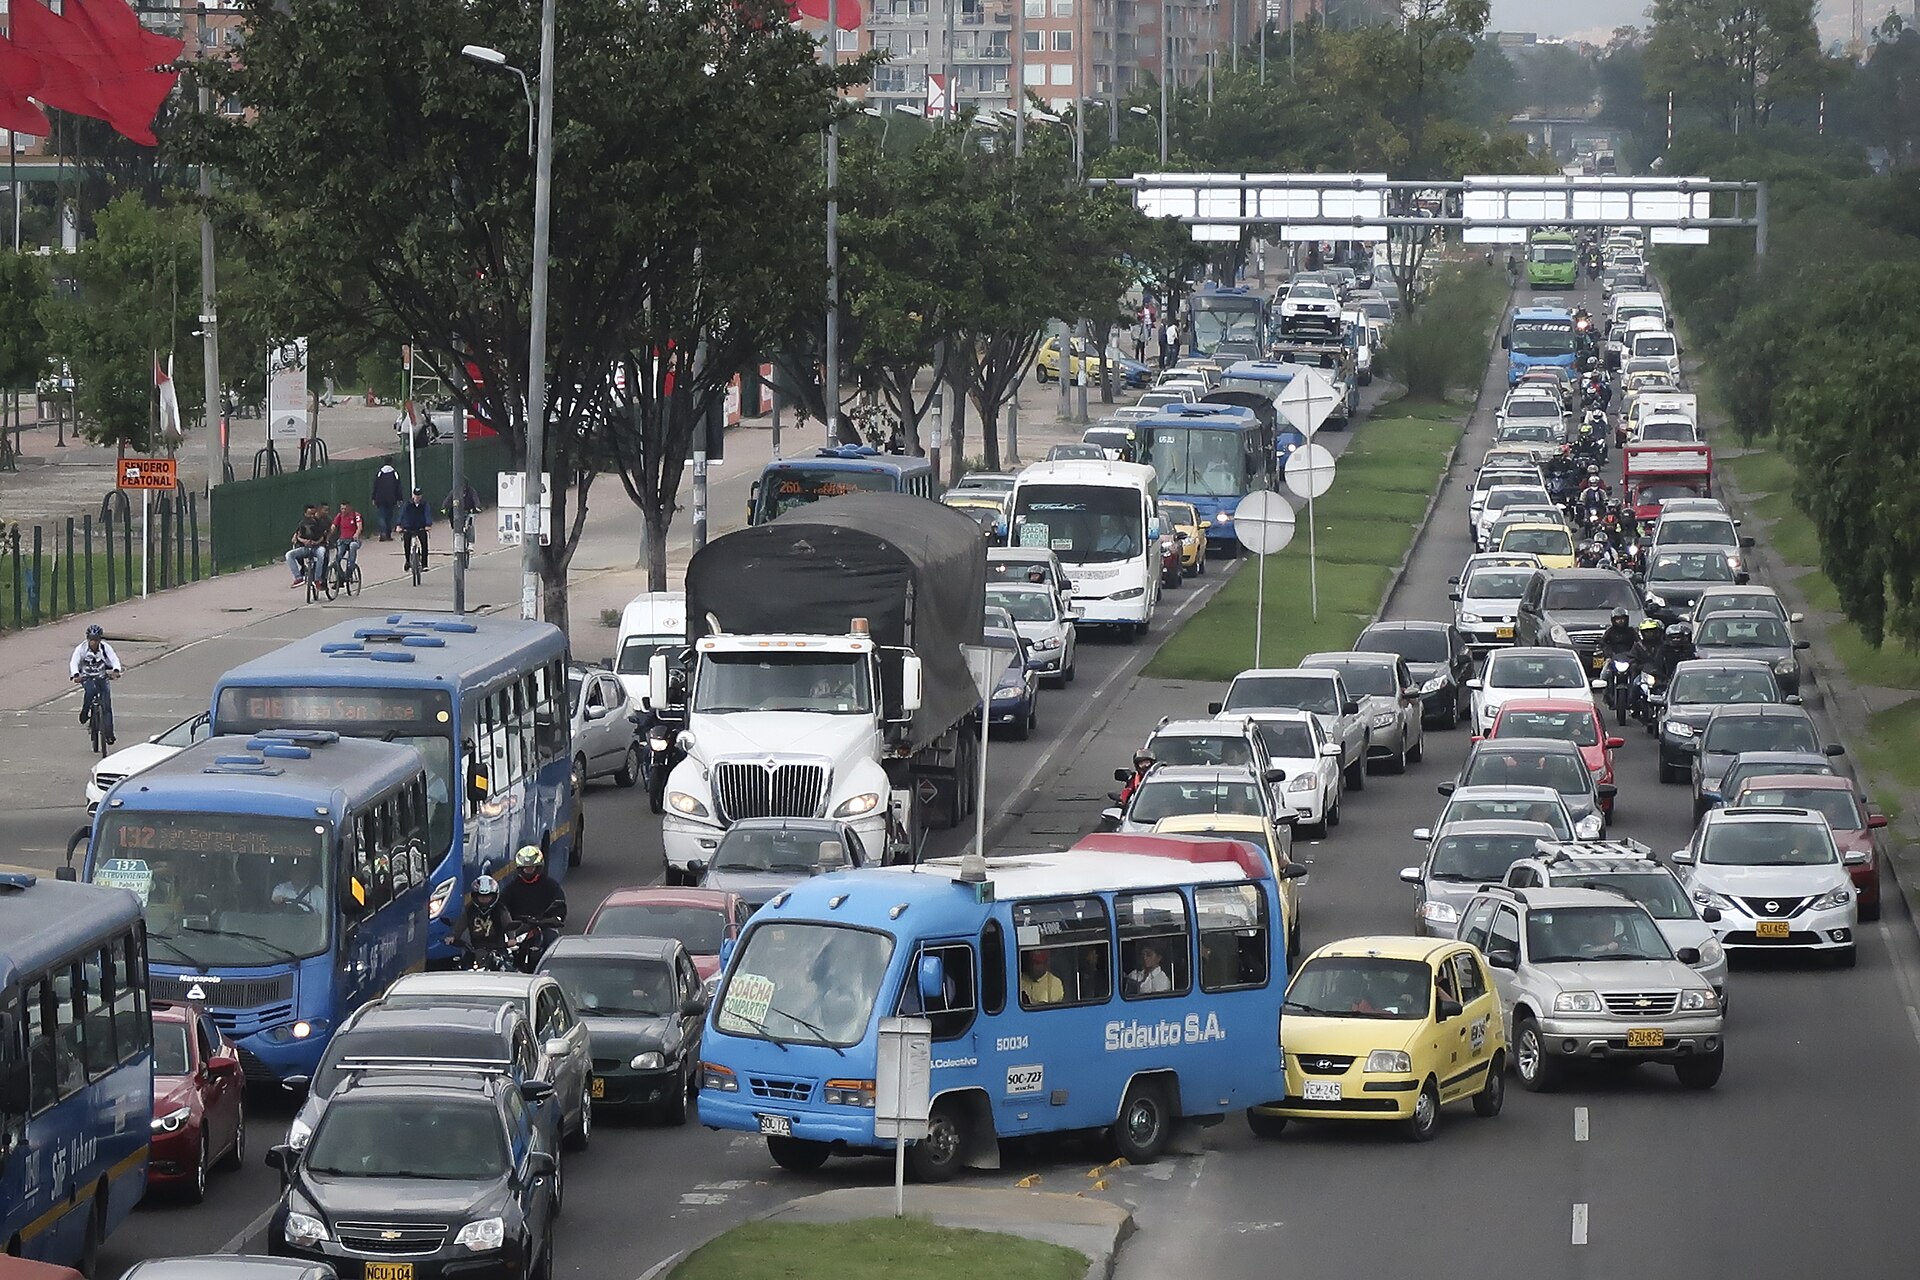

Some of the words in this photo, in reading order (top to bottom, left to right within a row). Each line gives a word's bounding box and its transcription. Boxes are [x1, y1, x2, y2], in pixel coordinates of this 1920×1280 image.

[124, 461, 170, 473] SENDERO
[121, 475, 172, 486] PEATONAL
[118, 825, 155, 849] 132
[116, 860, 137, 871] 132
[179, 974, 221, 984] Marcopolo
[728, 978, 773, 1002] SOACHA
[724, 997, 767, 1017] COMPARTIR
[1105, 1018, 1181, 1051] Sidauto
[1184, 1011, 1226, 1044] S.A.
[996, 1035, 1029, 1051] 50034
[1007, 1071, 1042, 1085] SOC-723
